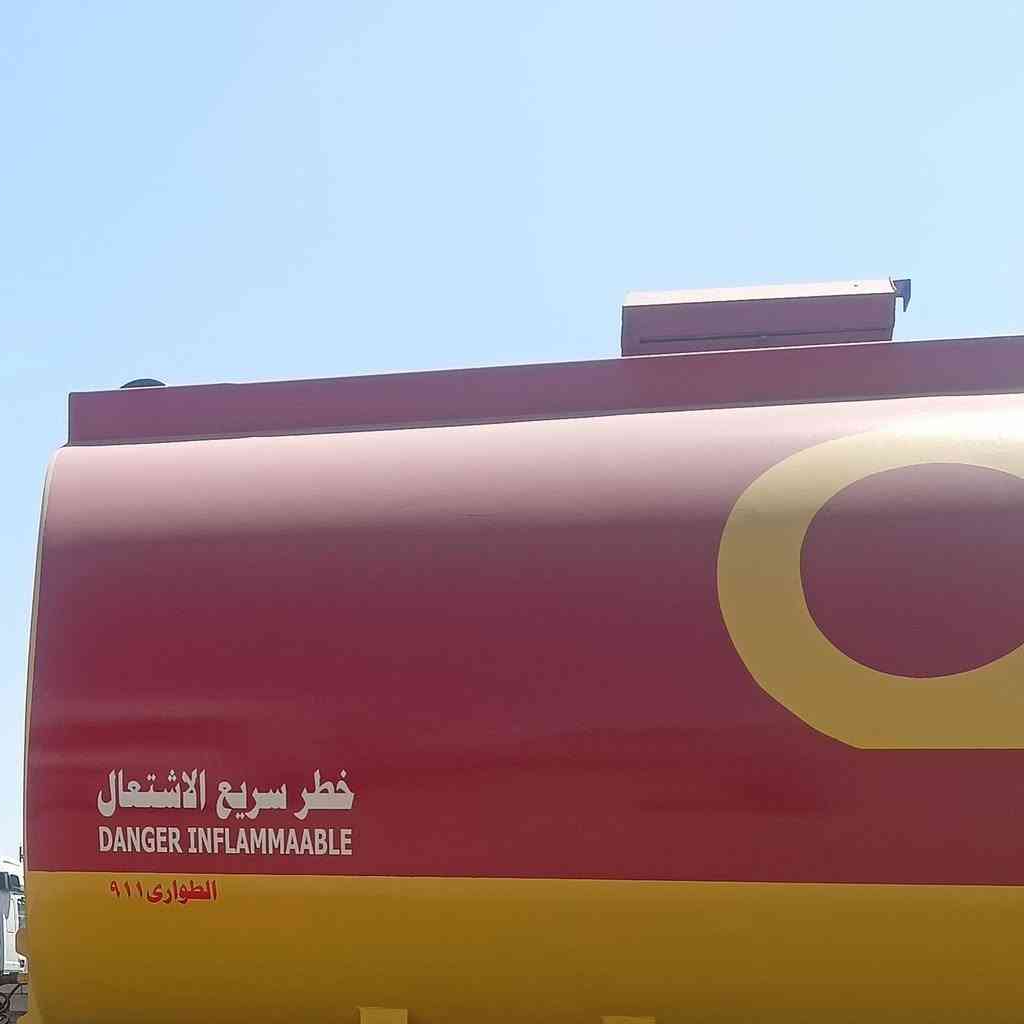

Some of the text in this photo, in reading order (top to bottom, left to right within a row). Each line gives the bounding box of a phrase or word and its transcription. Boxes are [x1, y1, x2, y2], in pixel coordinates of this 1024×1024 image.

[97, 767, 355, 820] خطر سريع الاشتعال
[98, 825, 353, 855] DANGER INFLAMMAABLE
